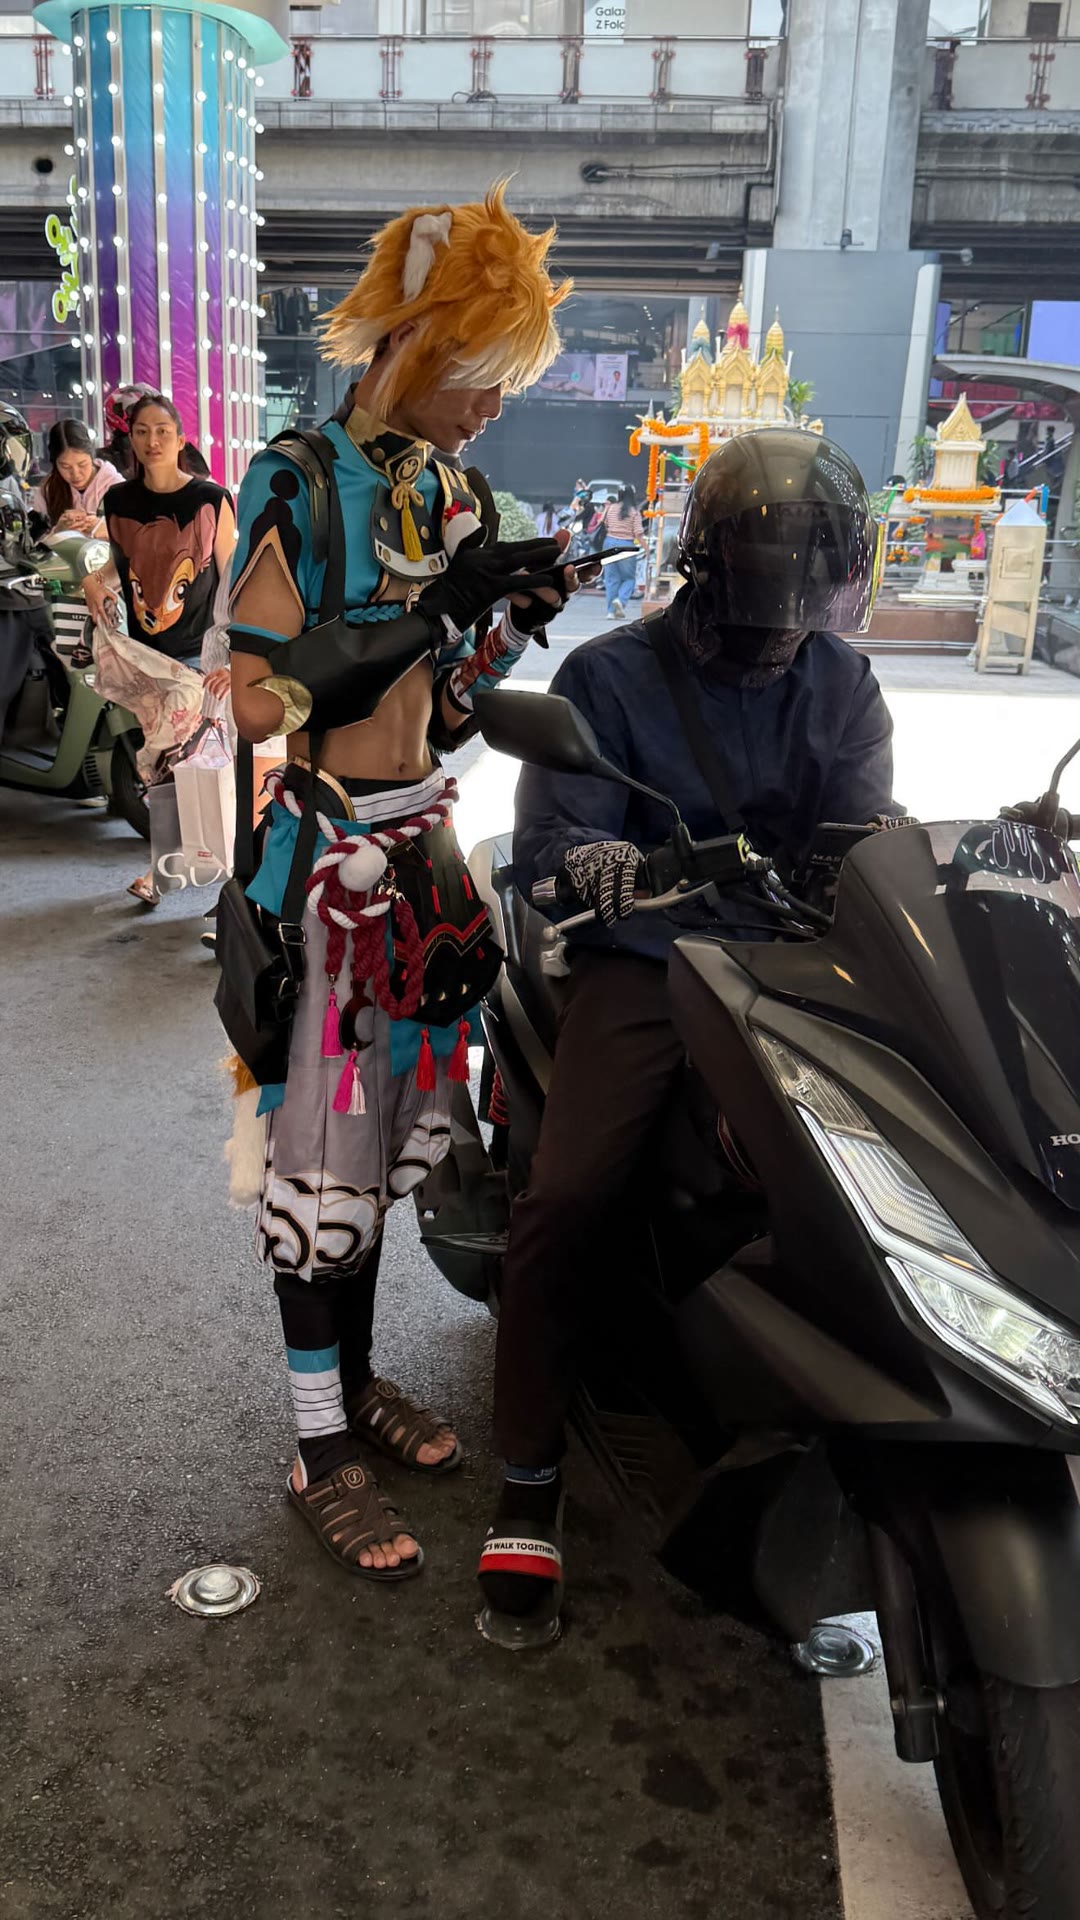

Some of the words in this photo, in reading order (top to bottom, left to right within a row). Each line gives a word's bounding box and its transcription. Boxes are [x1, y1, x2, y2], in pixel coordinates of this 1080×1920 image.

[596, 20, 603, 29] Z
[1050, 1133, 1080, 1147] HO
[494, 1542, 514, 1550] WALK
[516, 1542, 554, 1555] TOGETHER
